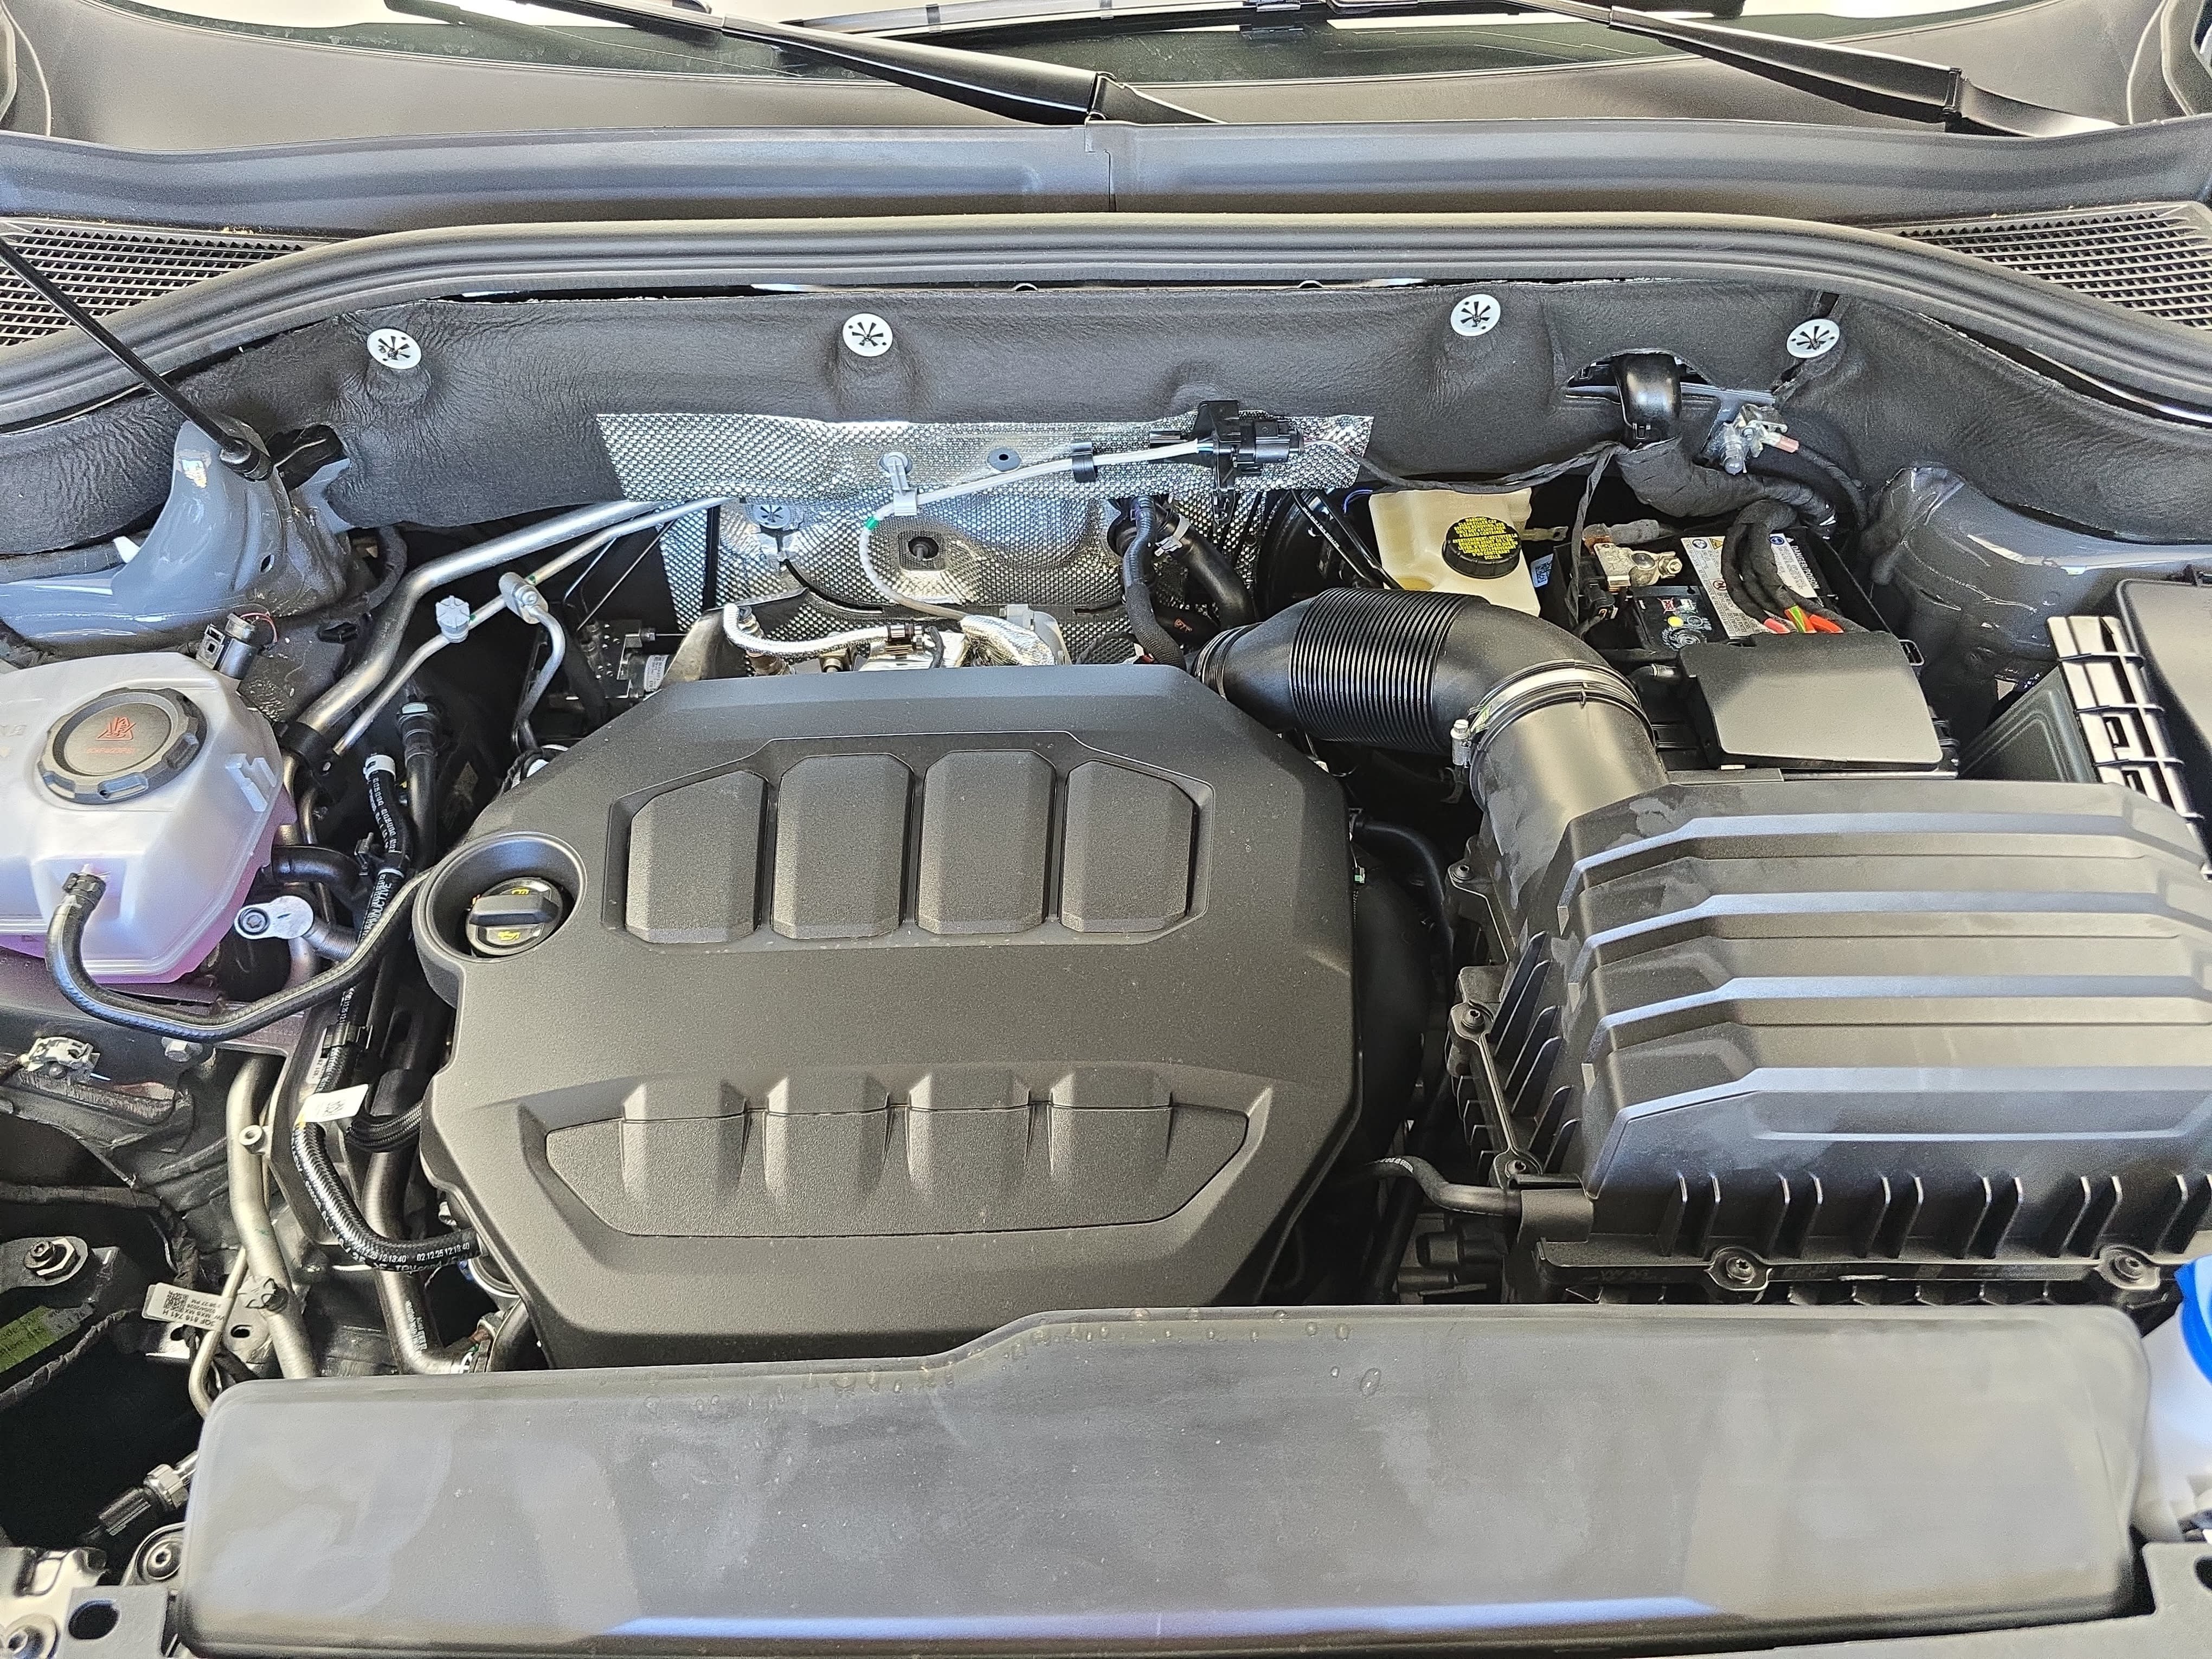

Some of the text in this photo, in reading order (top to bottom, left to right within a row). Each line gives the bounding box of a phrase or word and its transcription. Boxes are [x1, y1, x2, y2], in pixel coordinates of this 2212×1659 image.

[1791, 544, 1821, 590] DANGER/POISON
[170, 1311, 184, 1320] 741
[185, 1315, 200, 1323] 816
